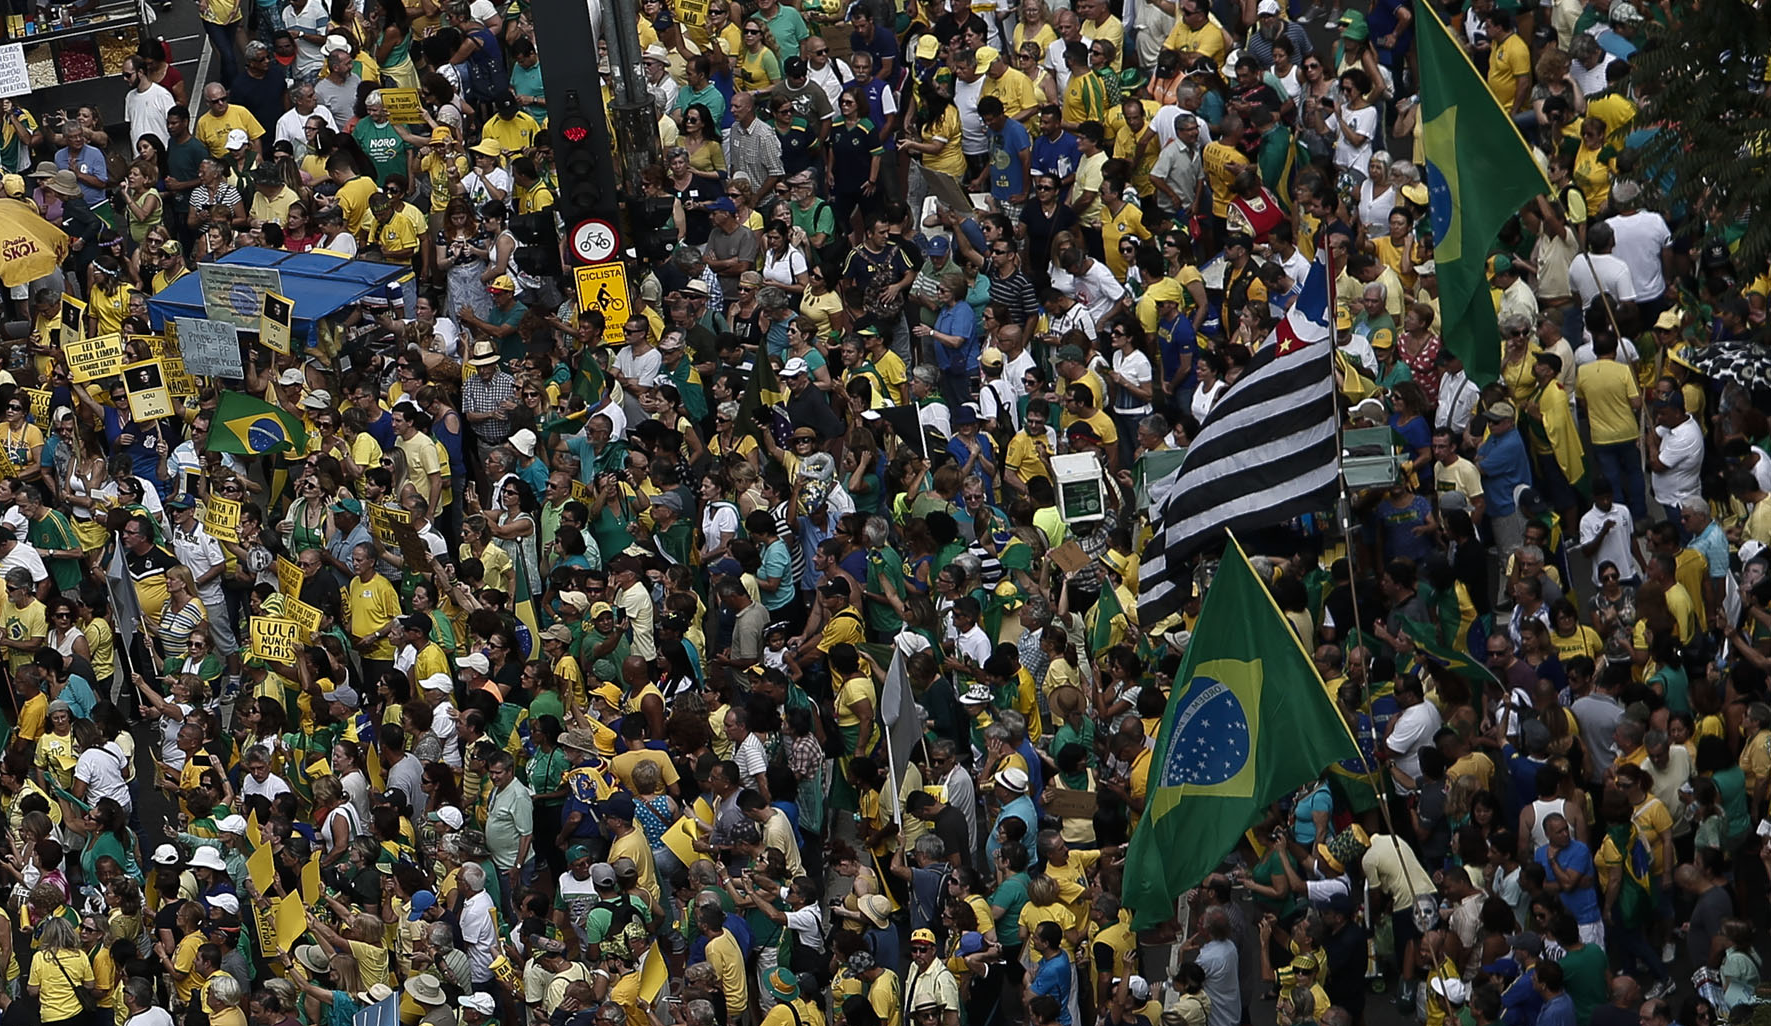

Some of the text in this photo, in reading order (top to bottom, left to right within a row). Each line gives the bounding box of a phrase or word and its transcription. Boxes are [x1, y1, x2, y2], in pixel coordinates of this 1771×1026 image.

[2, 241, 40, 263] SKOL
[579, 269, 622, 282] CICLISTA
[71, 348, 120, 364] FICHA LIMPA
[257, 622, 295, 638] LULA
